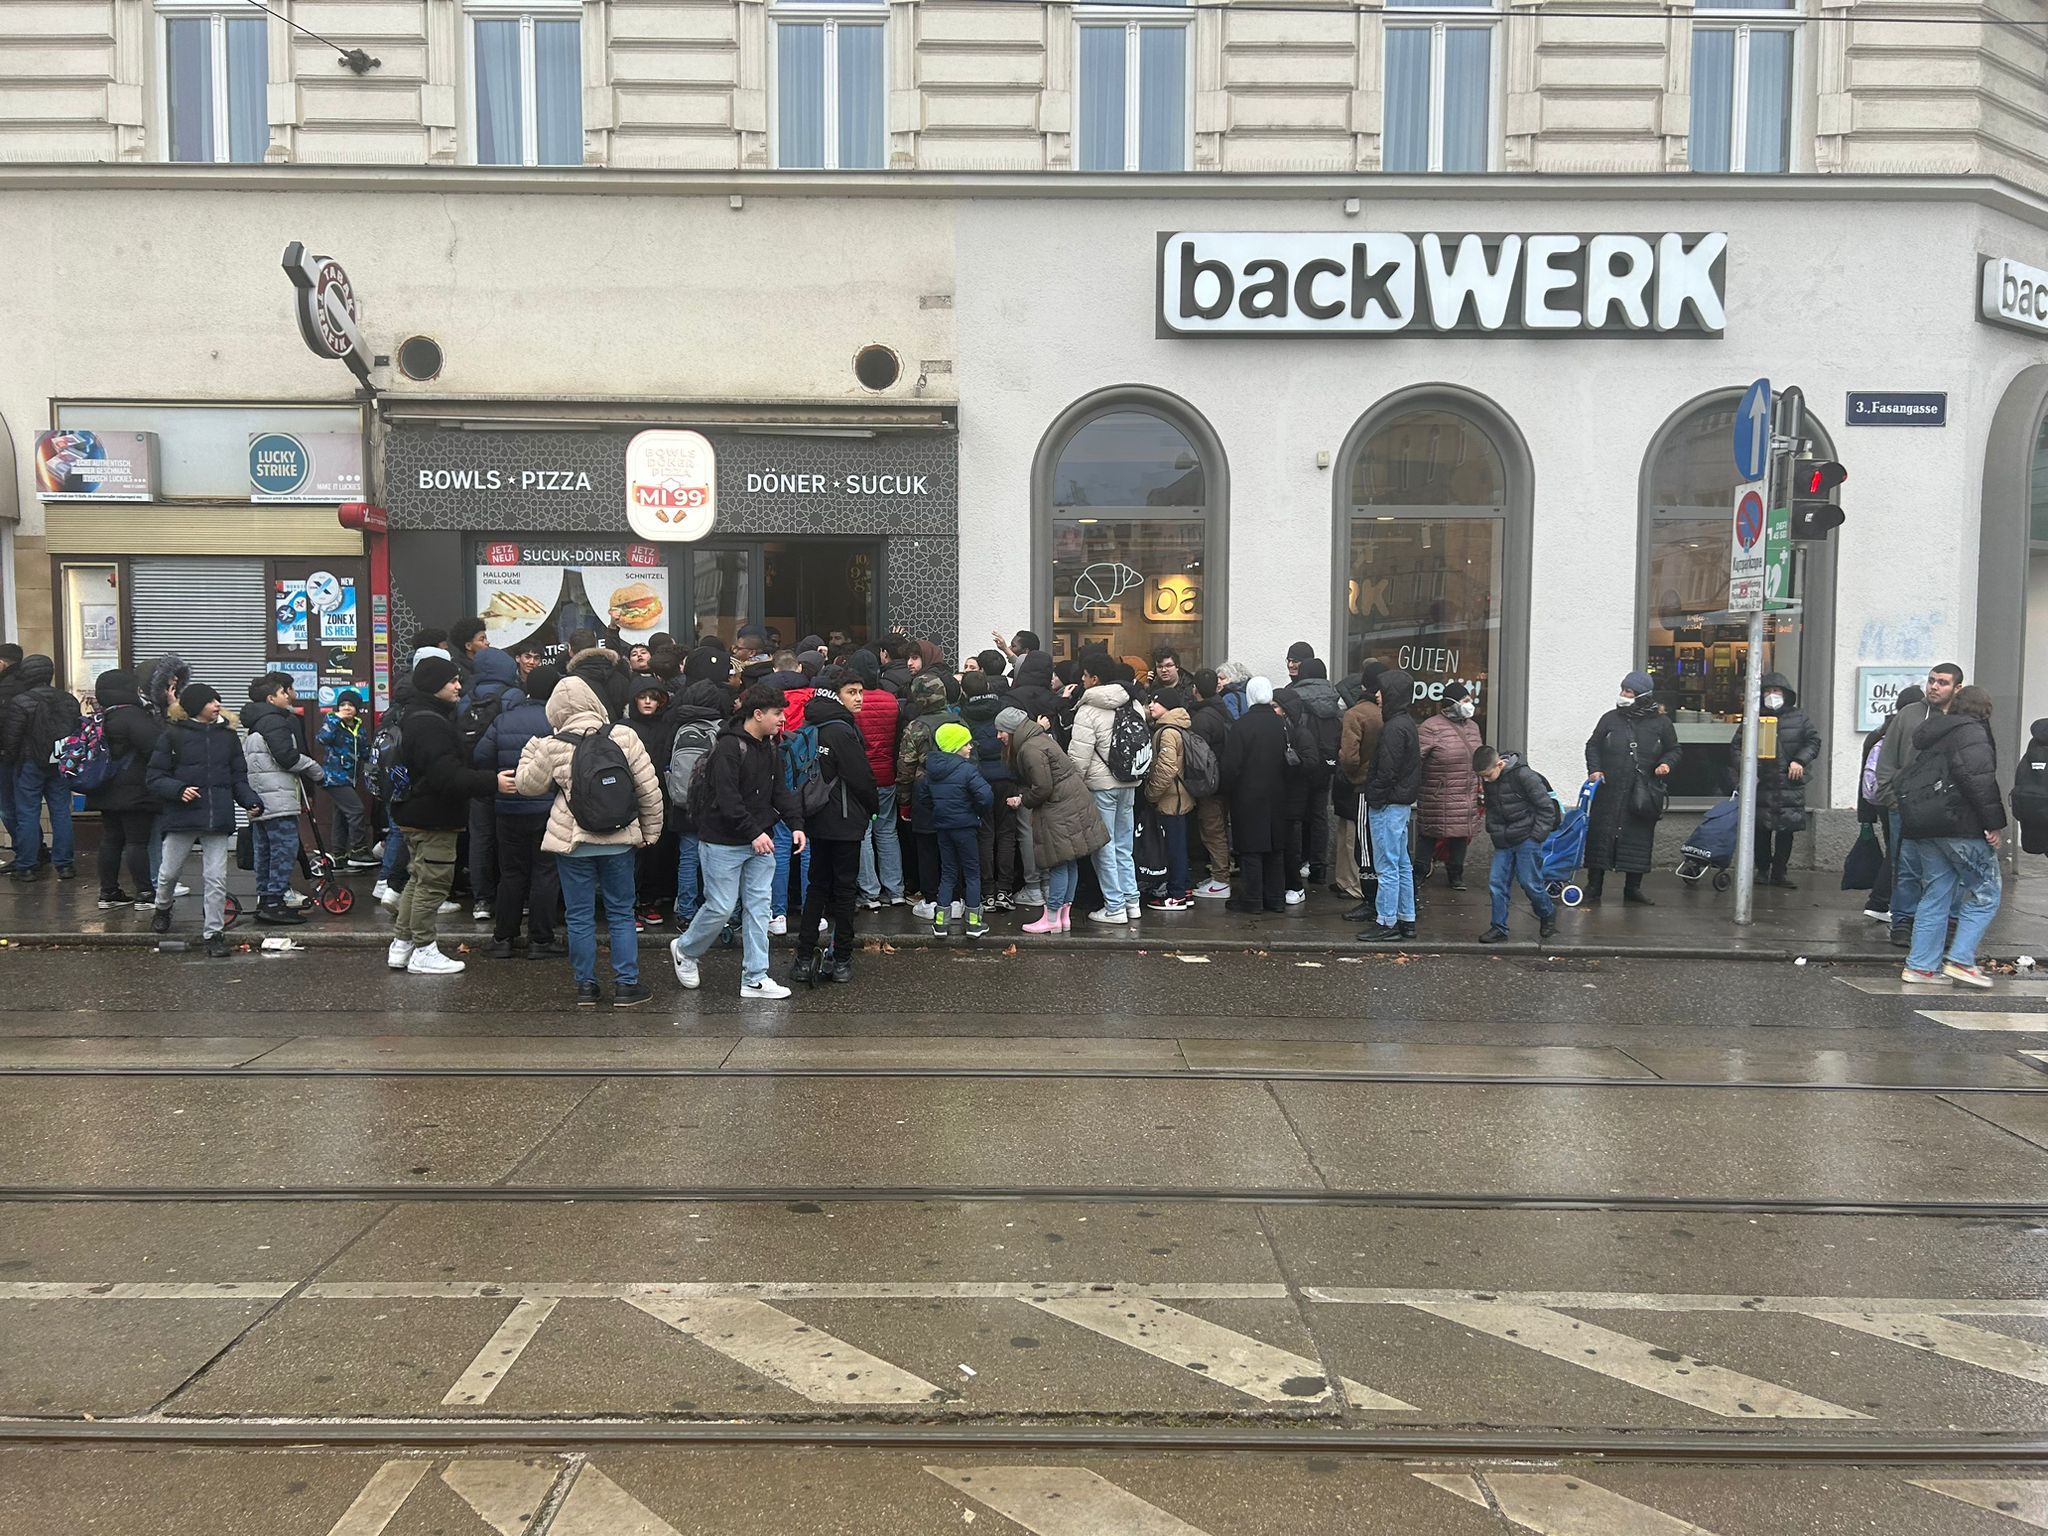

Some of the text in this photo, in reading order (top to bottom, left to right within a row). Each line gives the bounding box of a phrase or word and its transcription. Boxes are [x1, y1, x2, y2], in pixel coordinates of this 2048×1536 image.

[323, 266, 355, 313] TABAK
[2001, 262, 2048, 321] bac
[1871, 401, 1938, 416] Fasangasse
[258, 450, 296, 463] LUCKY
[256, 464, 298, 477] STRIKE
[418, 470, 592, 491] BOWLS PIZZA
[747, 467, 928, 495] DÖNER SUCUK
[640, 488, 703, 507] MI 99
[490, 545, 514, 555] JETZ
[523, 548, 621, 562] SUCUK-DÖNER
[492, 553, 515, 564] NEU!
[631, 555, 654, 565] NEU!
[482, 571, 521, 579] HALLOUMI
[625, 572, 665, 580] SCHNITZEL
[482, 578, 521, 586] GRILL-KÄSE
[327, 613, 355, 625] ZONE X
[325, 625, 355, 637] IS HERE
[1398, 645, 1459, 673] GUTEN
